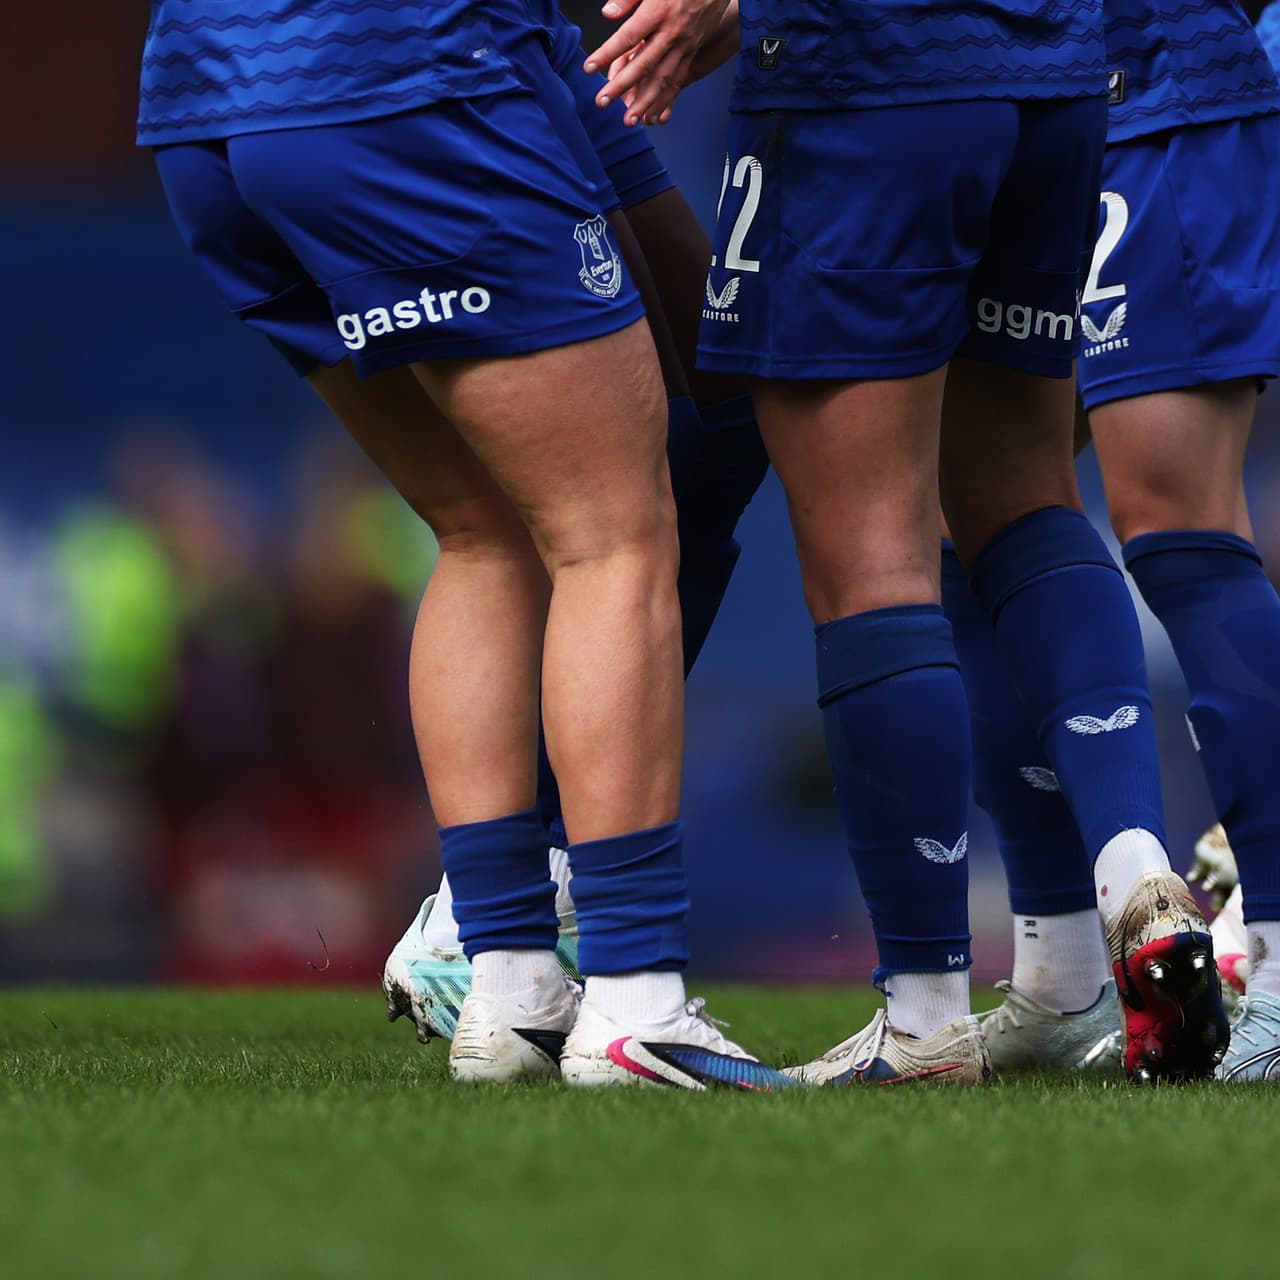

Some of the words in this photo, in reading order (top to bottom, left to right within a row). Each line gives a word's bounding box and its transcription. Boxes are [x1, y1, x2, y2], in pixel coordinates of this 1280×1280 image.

[710, 151, 763, 273] 2
[336, 285, 492, 351] gastro
[1084, 336, 1130, 359] CASTORE
